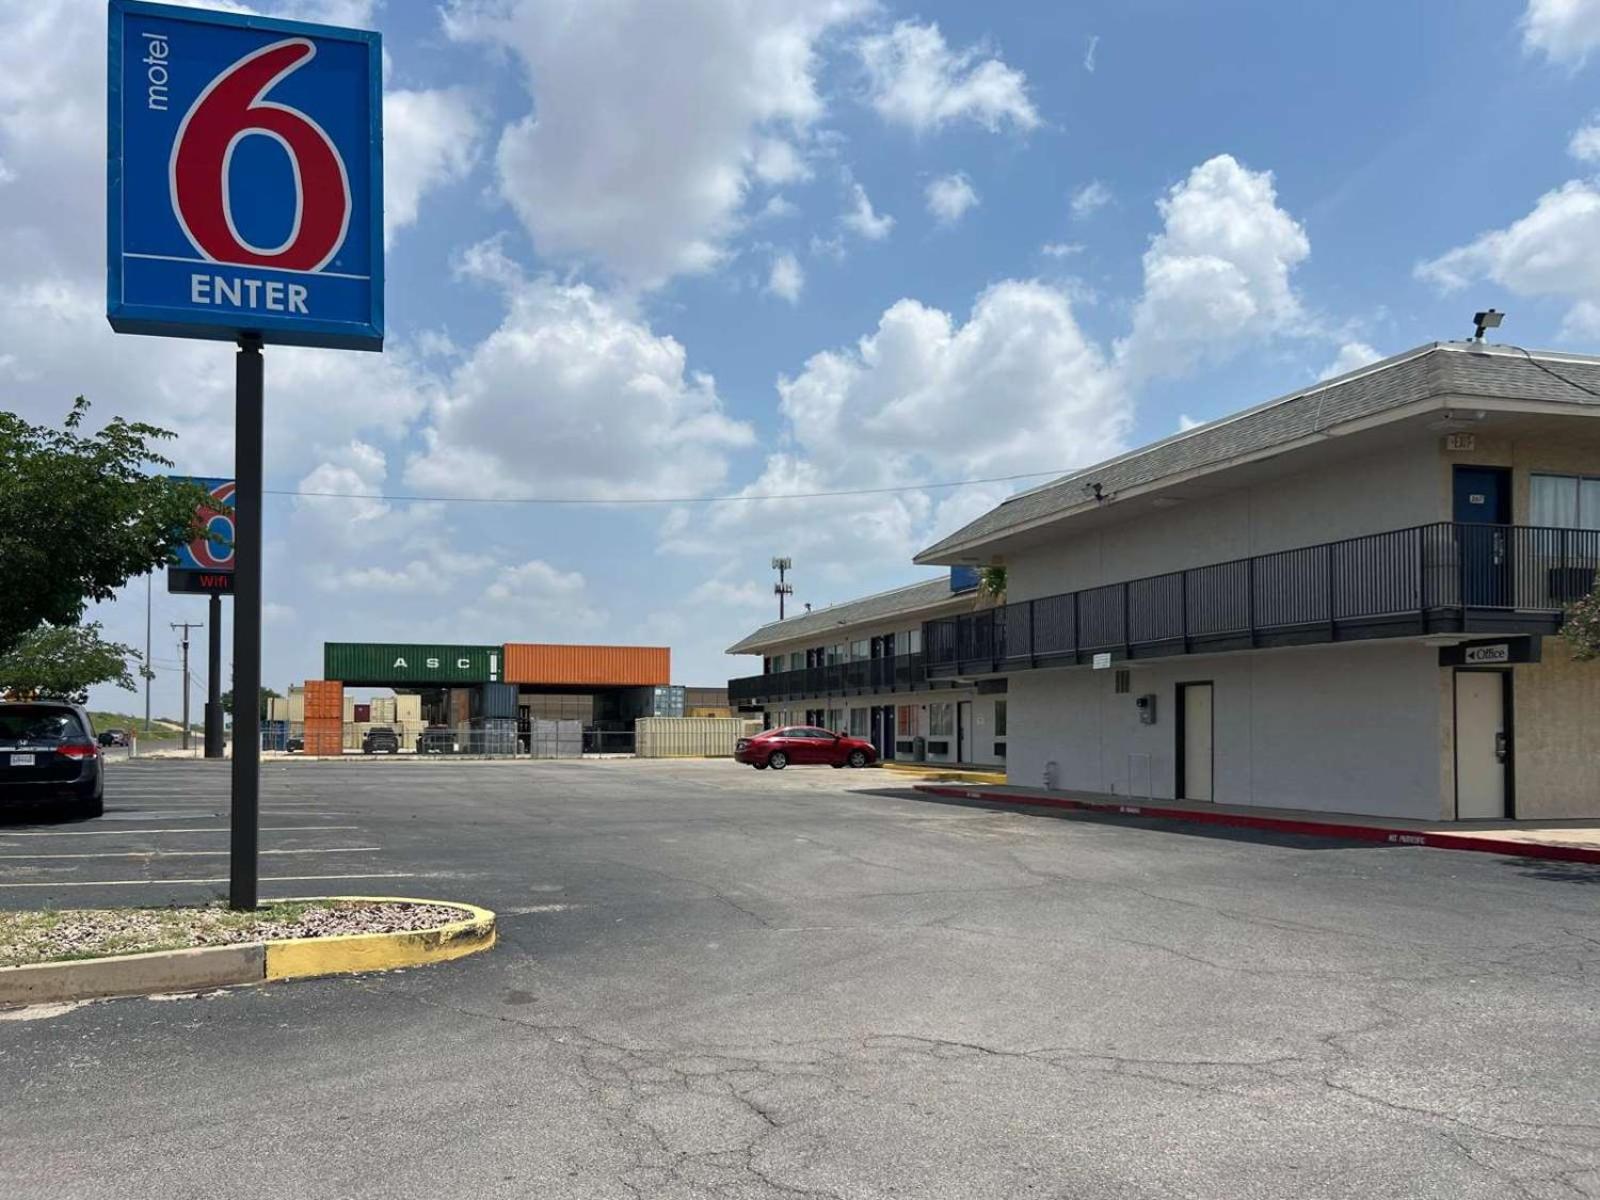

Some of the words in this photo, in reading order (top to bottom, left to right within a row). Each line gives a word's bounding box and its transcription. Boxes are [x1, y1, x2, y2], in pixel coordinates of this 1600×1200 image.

[142, 33, 169, 111] motel
[169, 37, 352, 272] 6
[191, 275, 309, 314] ENTER
[1477, 648, 1505, 659] Office
